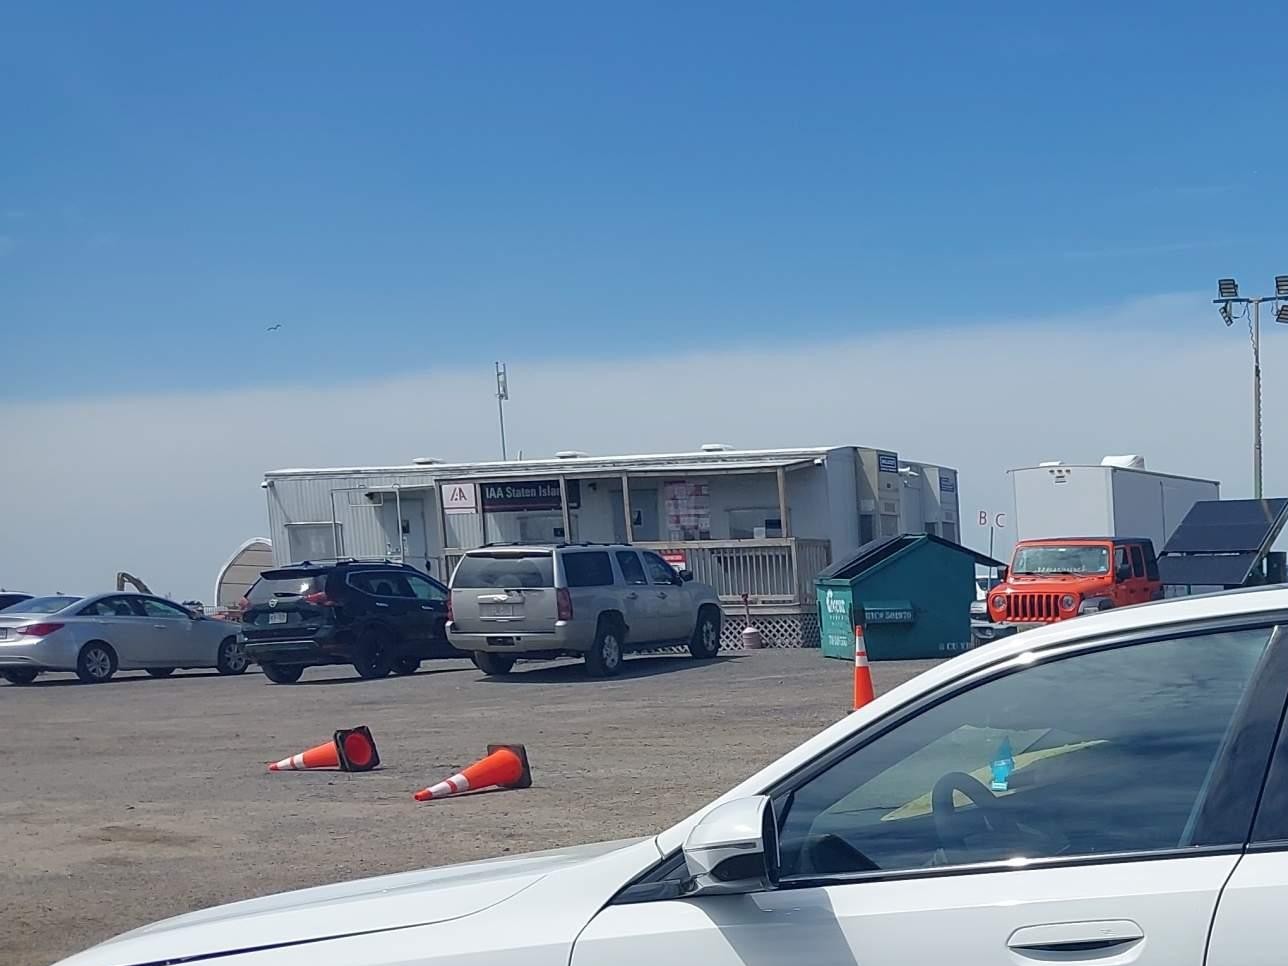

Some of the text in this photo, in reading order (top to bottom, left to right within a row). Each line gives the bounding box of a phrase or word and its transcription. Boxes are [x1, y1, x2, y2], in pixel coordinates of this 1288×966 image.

[485, 484, 561, 498] IAA Staten Islan
[979, 511, 987, 525] B
[995, 513, 1006, 527] C
